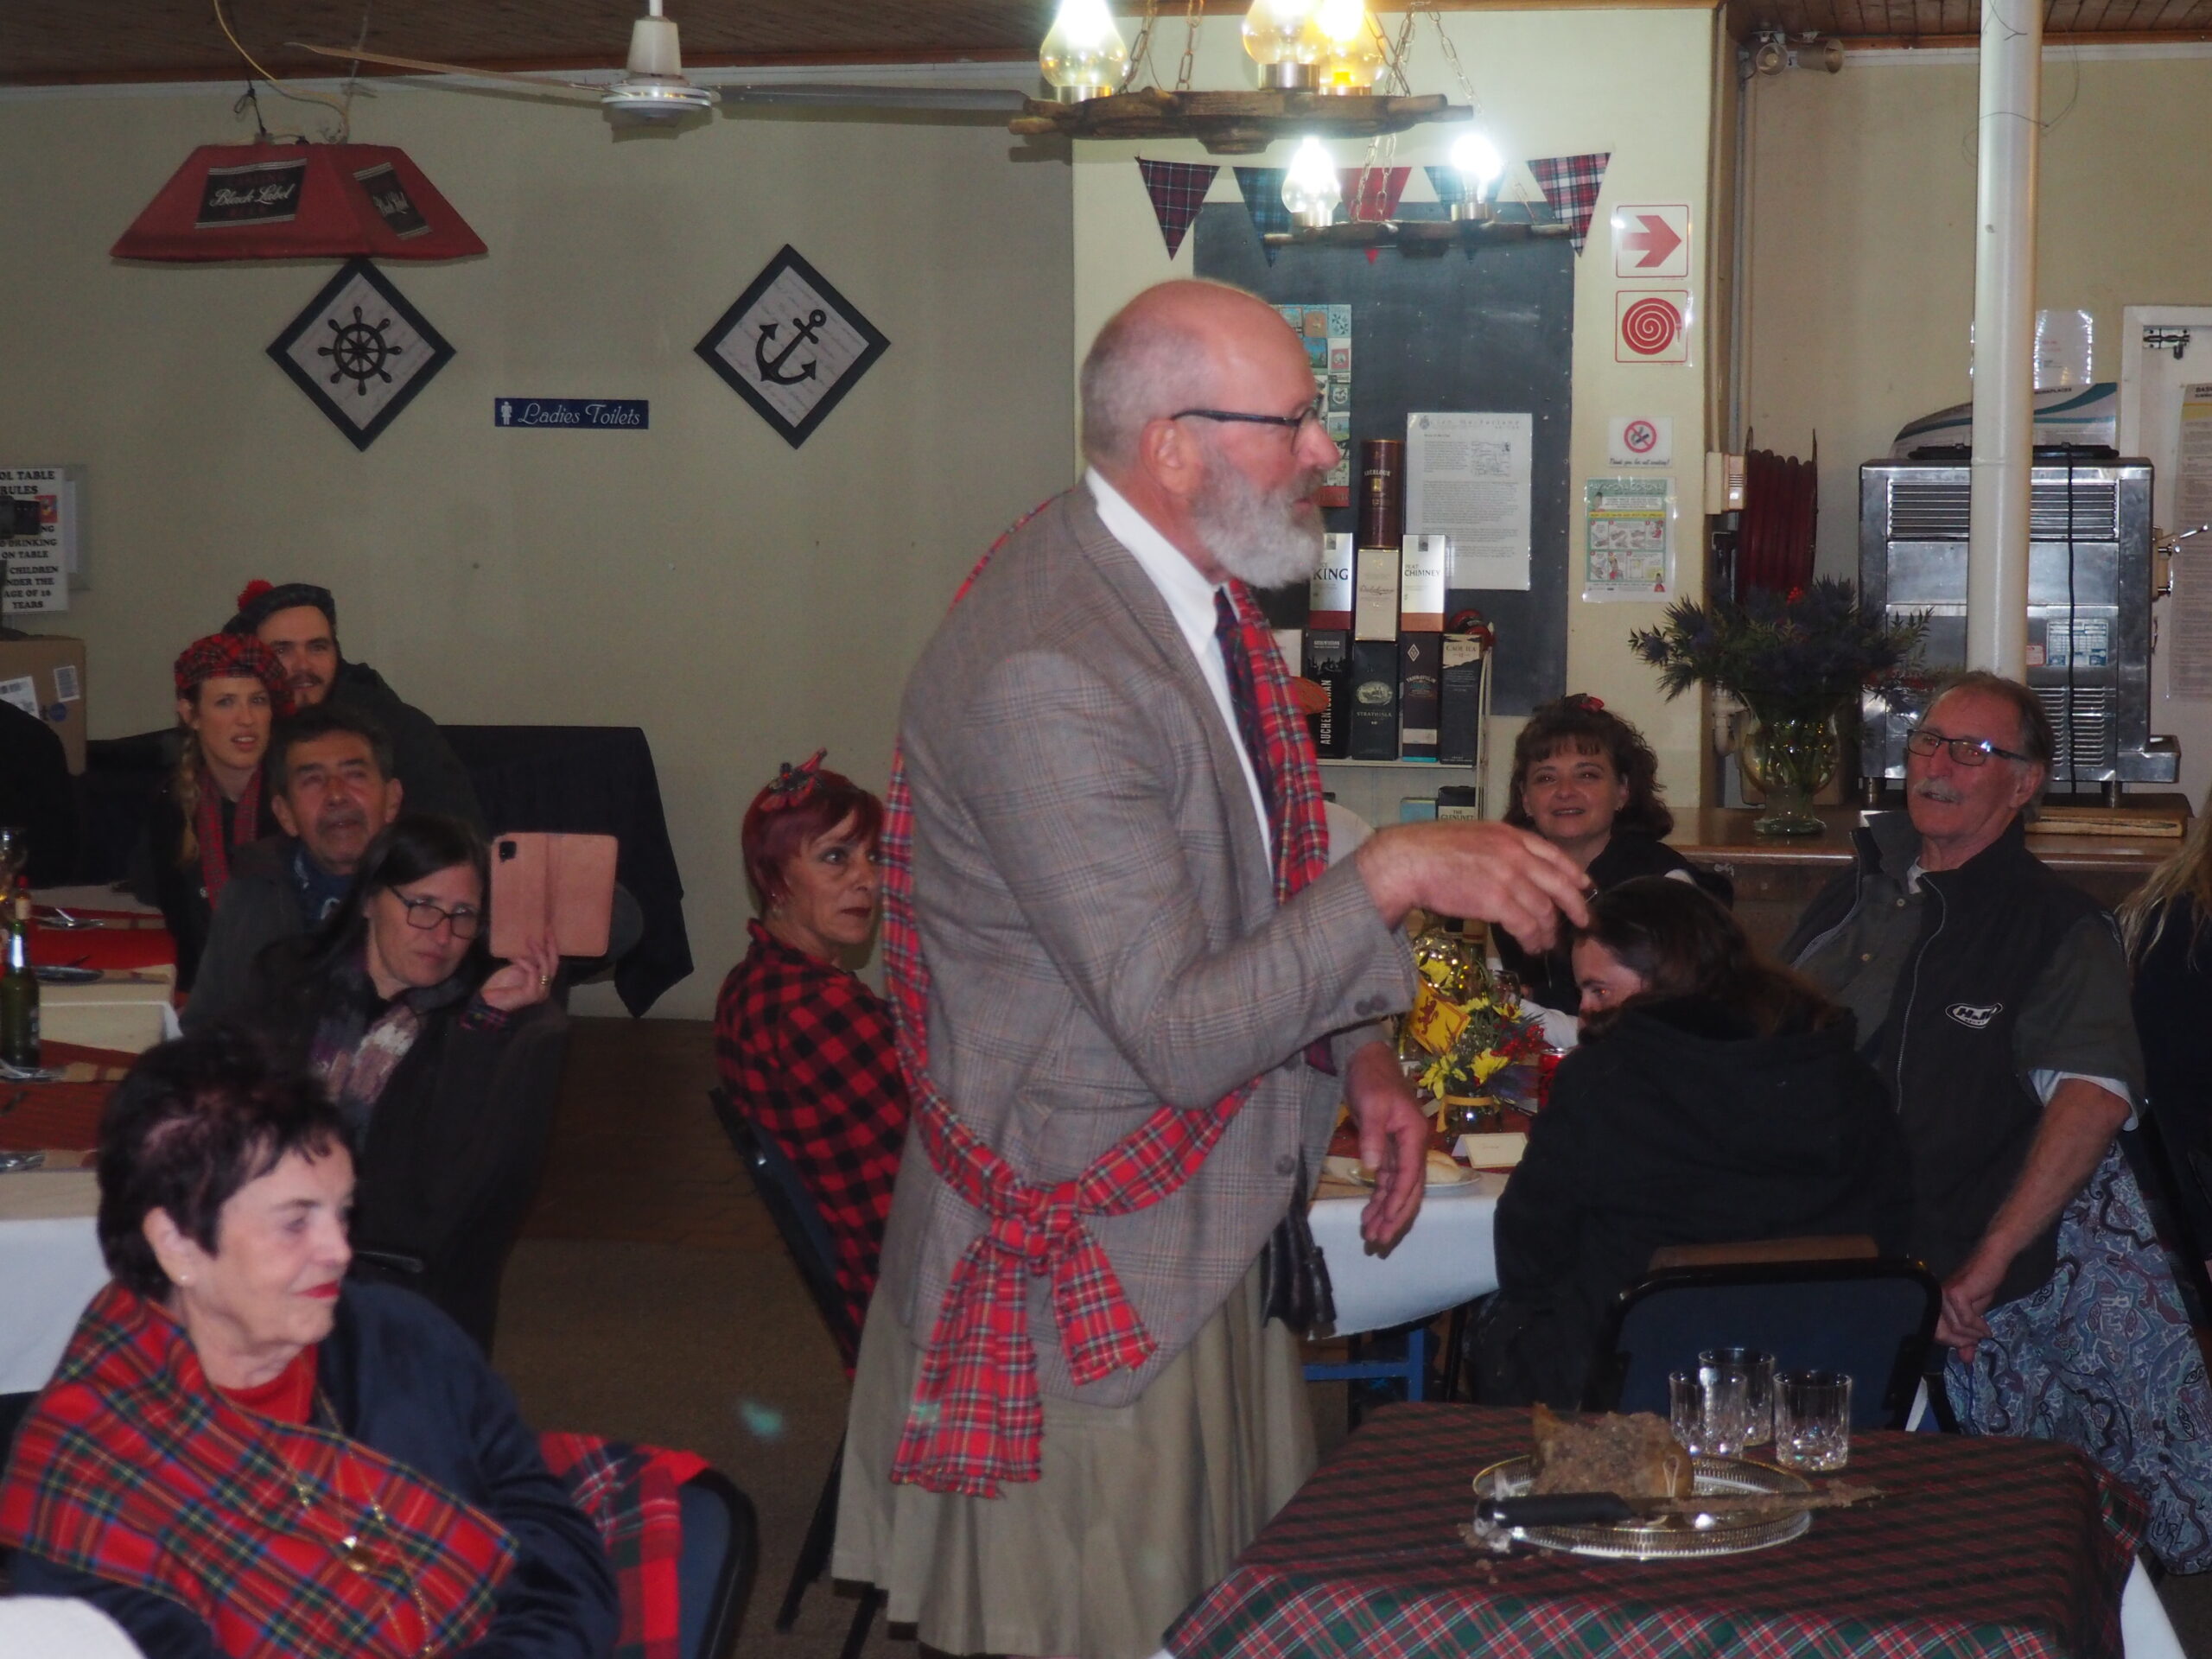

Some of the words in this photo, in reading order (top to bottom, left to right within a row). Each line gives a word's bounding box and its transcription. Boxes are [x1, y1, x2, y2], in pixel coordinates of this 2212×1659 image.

[255, 183, 296, 205] Label
[518, 403, 580, 424] Ladies
[585, 404, 640, 425] Toilets
[16, 470, 55, 480] TABLE
[0, 486, 39, 494] RULES
[1313, 569, 1349, 581] KING
[12, 601, 44, 609] YEARS
